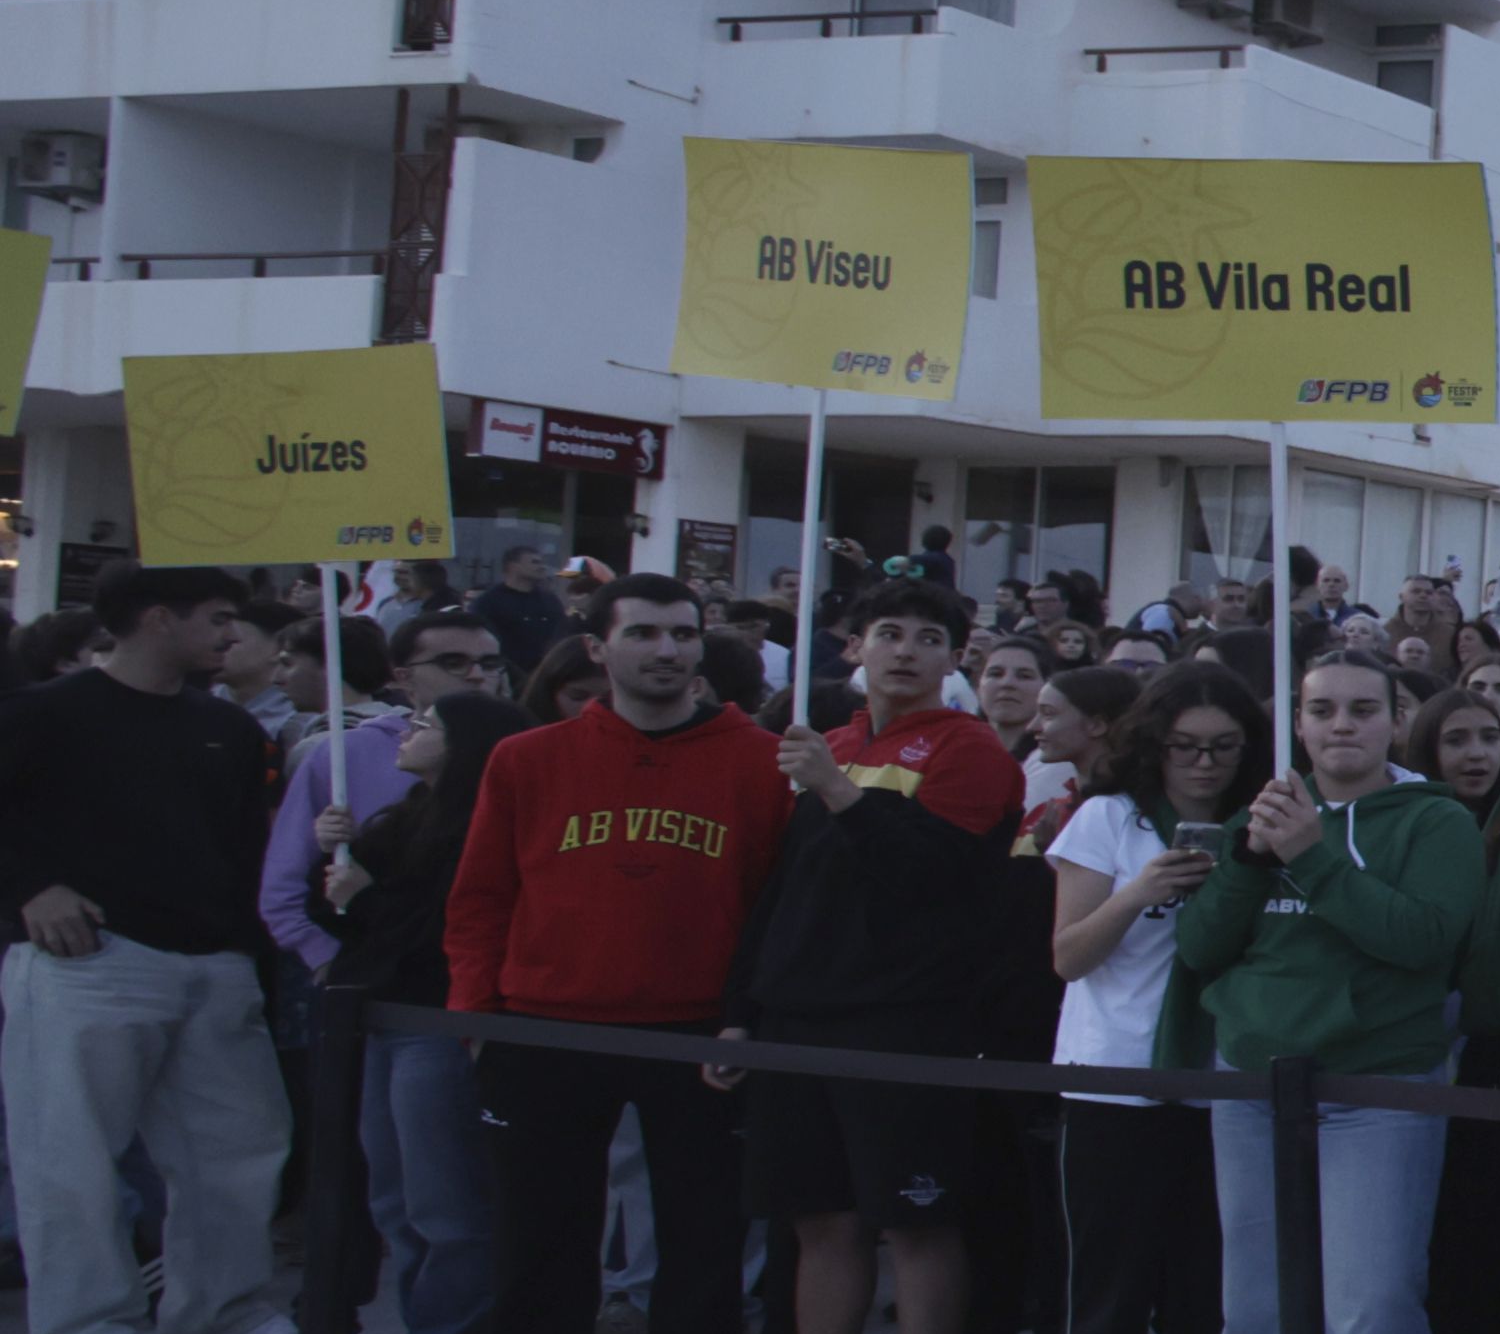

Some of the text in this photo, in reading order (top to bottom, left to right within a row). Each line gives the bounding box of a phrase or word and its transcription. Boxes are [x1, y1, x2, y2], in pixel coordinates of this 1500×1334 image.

[757, 235, 891, 290] AB Viseu
[1123, 260, 1411, 312] AB Vila Real
[849, 352, 892, 375] FPB
[1324, 380, 1389, 403] FPB
[256, 432, 368, 474] Juízes
[354, 525, 394, 544] FPB
[557, 807, 728, 859] AB VISEU
